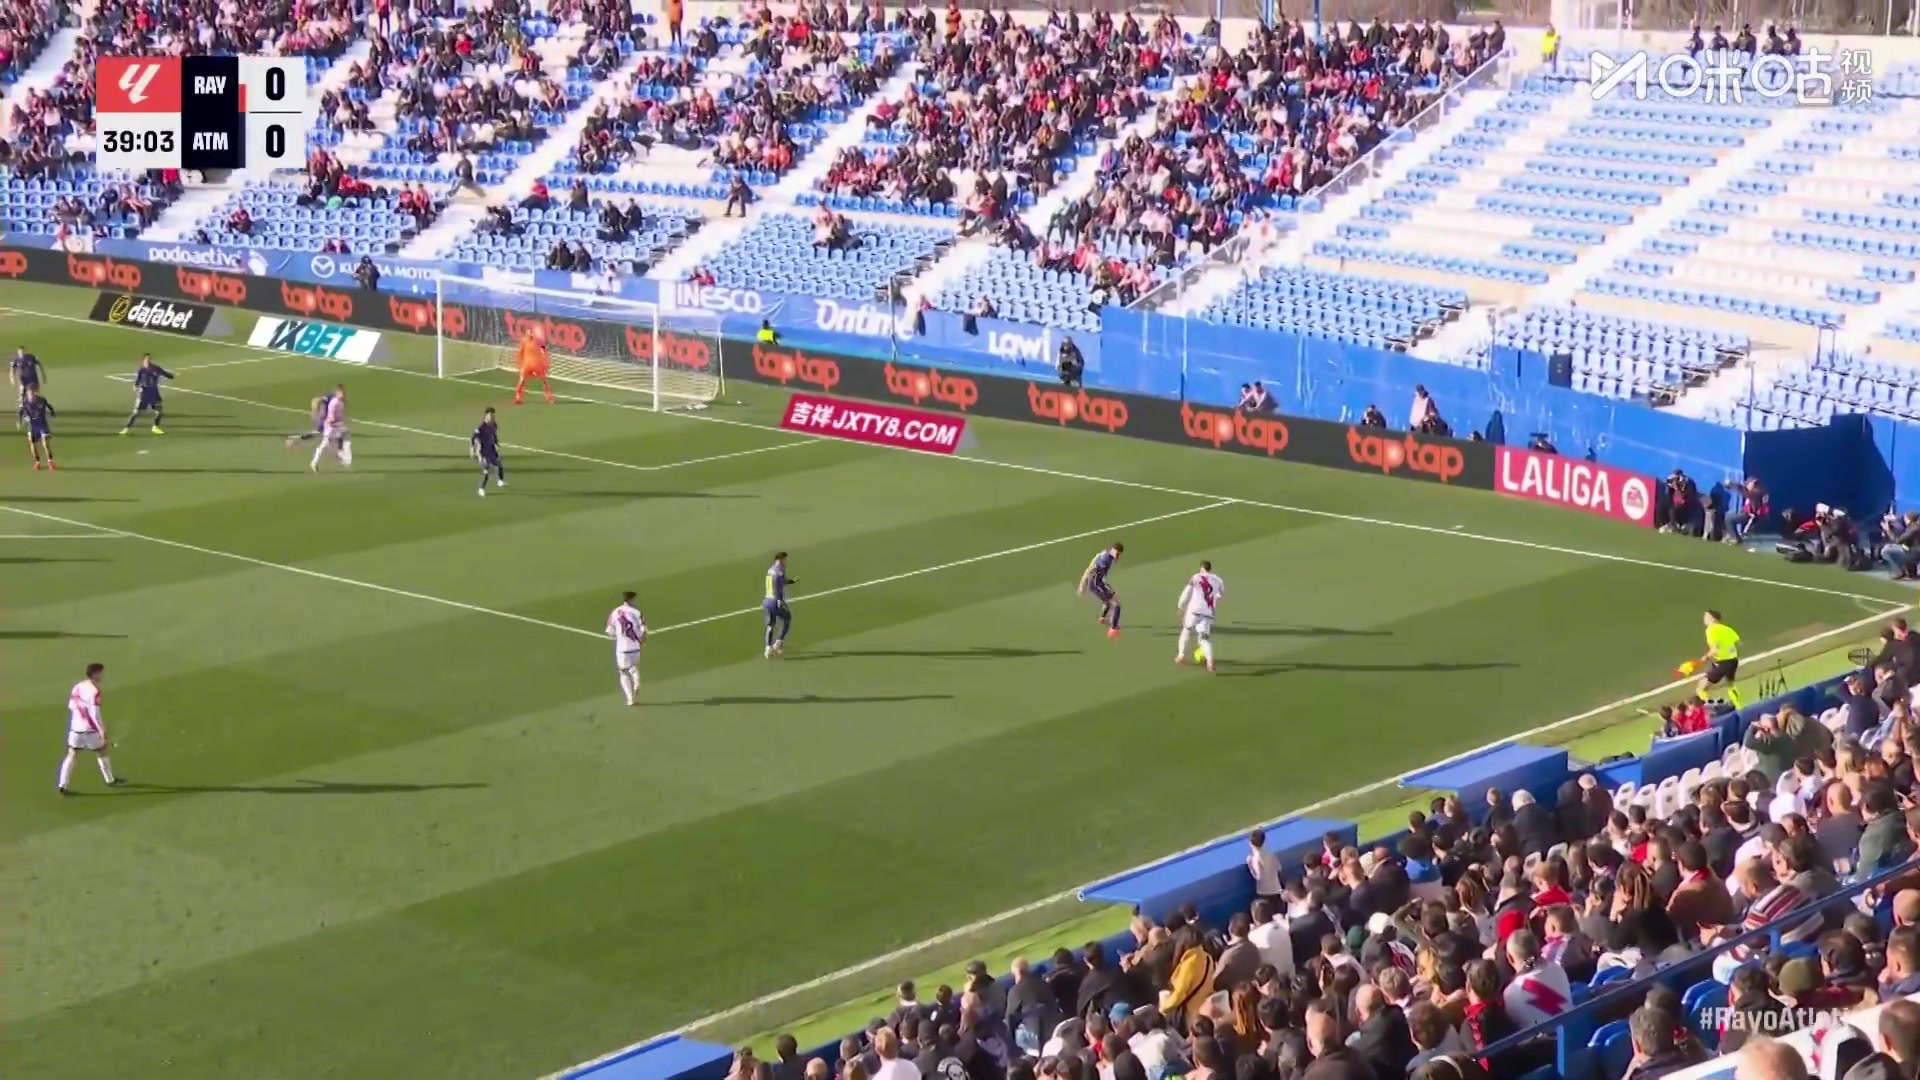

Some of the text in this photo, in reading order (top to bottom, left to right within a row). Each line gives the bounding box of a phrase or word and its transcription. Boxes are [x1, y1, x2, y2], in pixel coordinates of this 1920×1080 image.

[67, 252, 141, 291] taptap
[176, 266, 247, 306] taptap
[127, 300, 193, 330] dafabet
[280, 280, 353, 322] taptap
[390, 296, 466, 338] taptap
[268, 319, 356, 356] 1XBET
[752, 344, 840, 391] taptap
[885, 364, 978, 411] taptap
[1028, 382, 1129, 432] taptap
[1181, 402, 1289, 455] taptap
[1347, 425, 1464, 483] taptap
[1502, 451, 1611, 512] LALIGA
